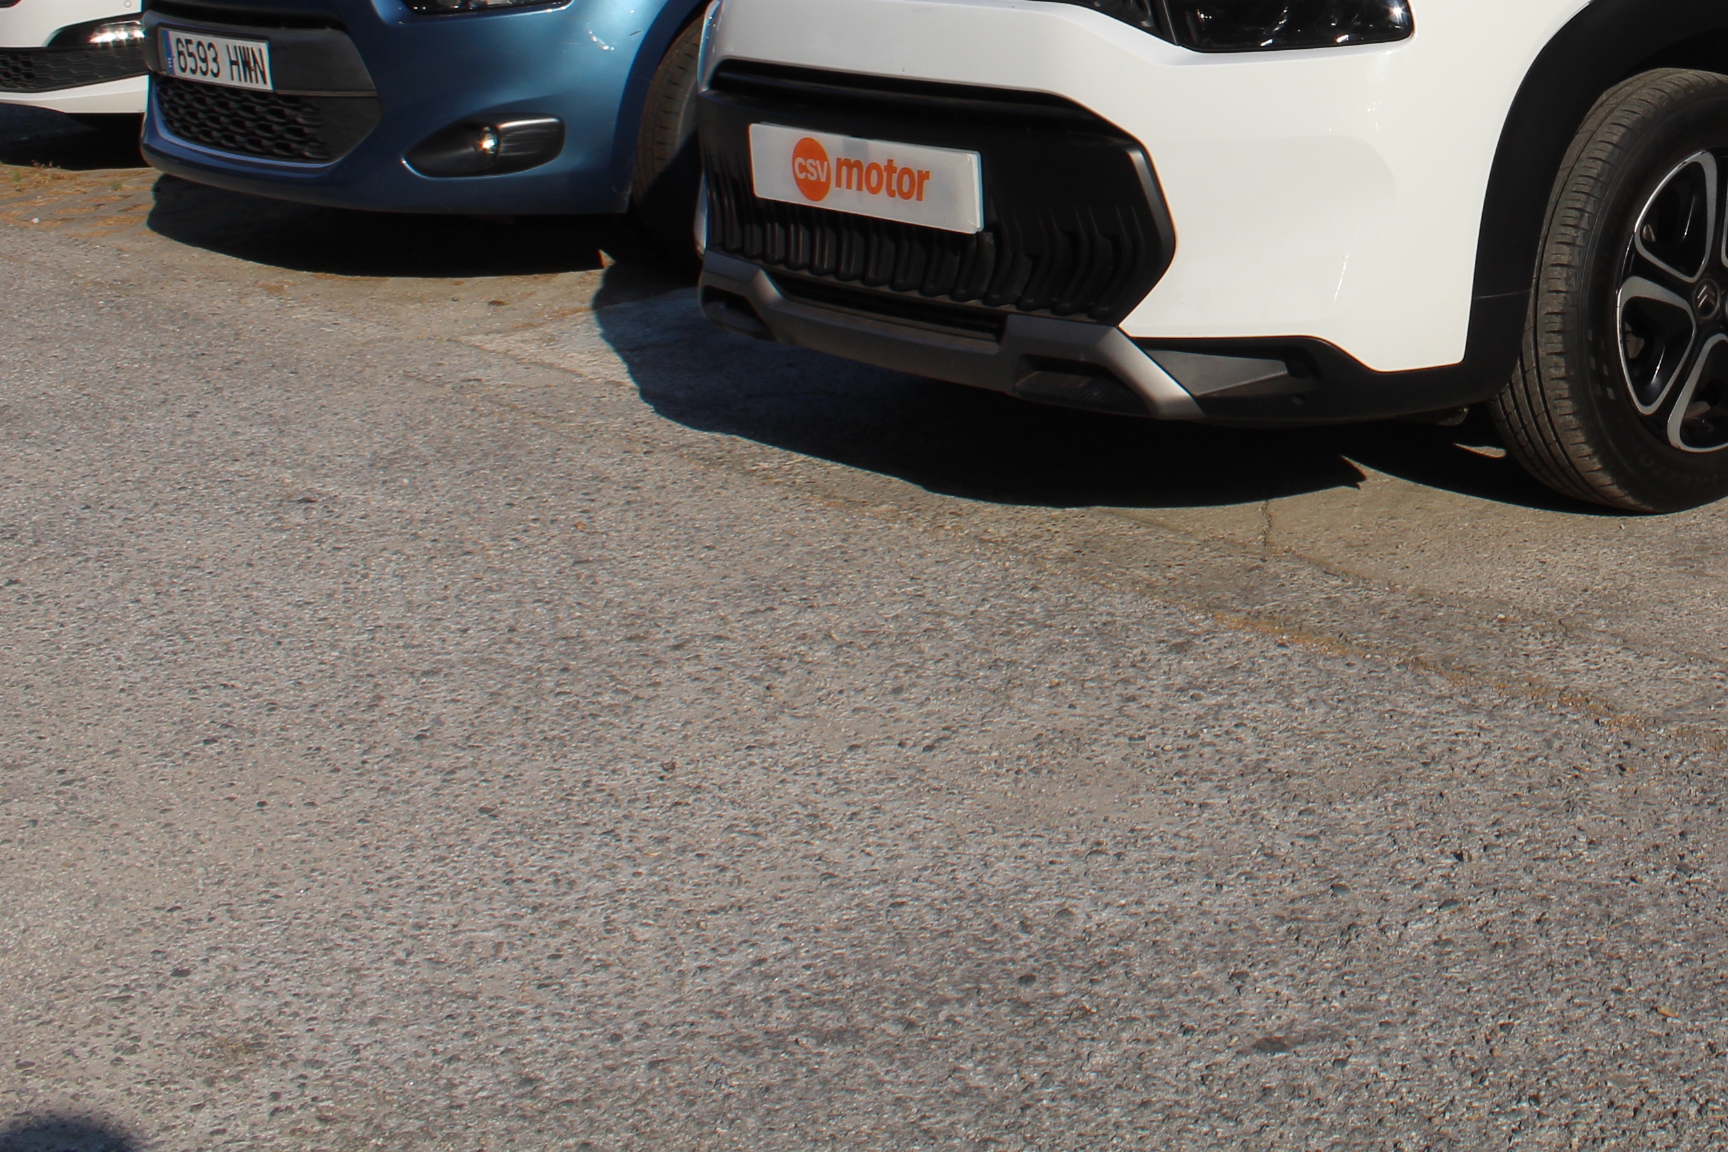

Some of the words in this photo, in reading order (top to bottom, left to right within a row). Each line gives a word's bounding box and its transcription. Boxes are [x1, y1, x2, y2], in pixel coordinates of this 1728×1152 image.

[175, 37, 221, 78] 6593
[225, 44, 268, 85] HWN
[793, 156, 829, 183] CSV
[835, 156, 931, 202] motor
